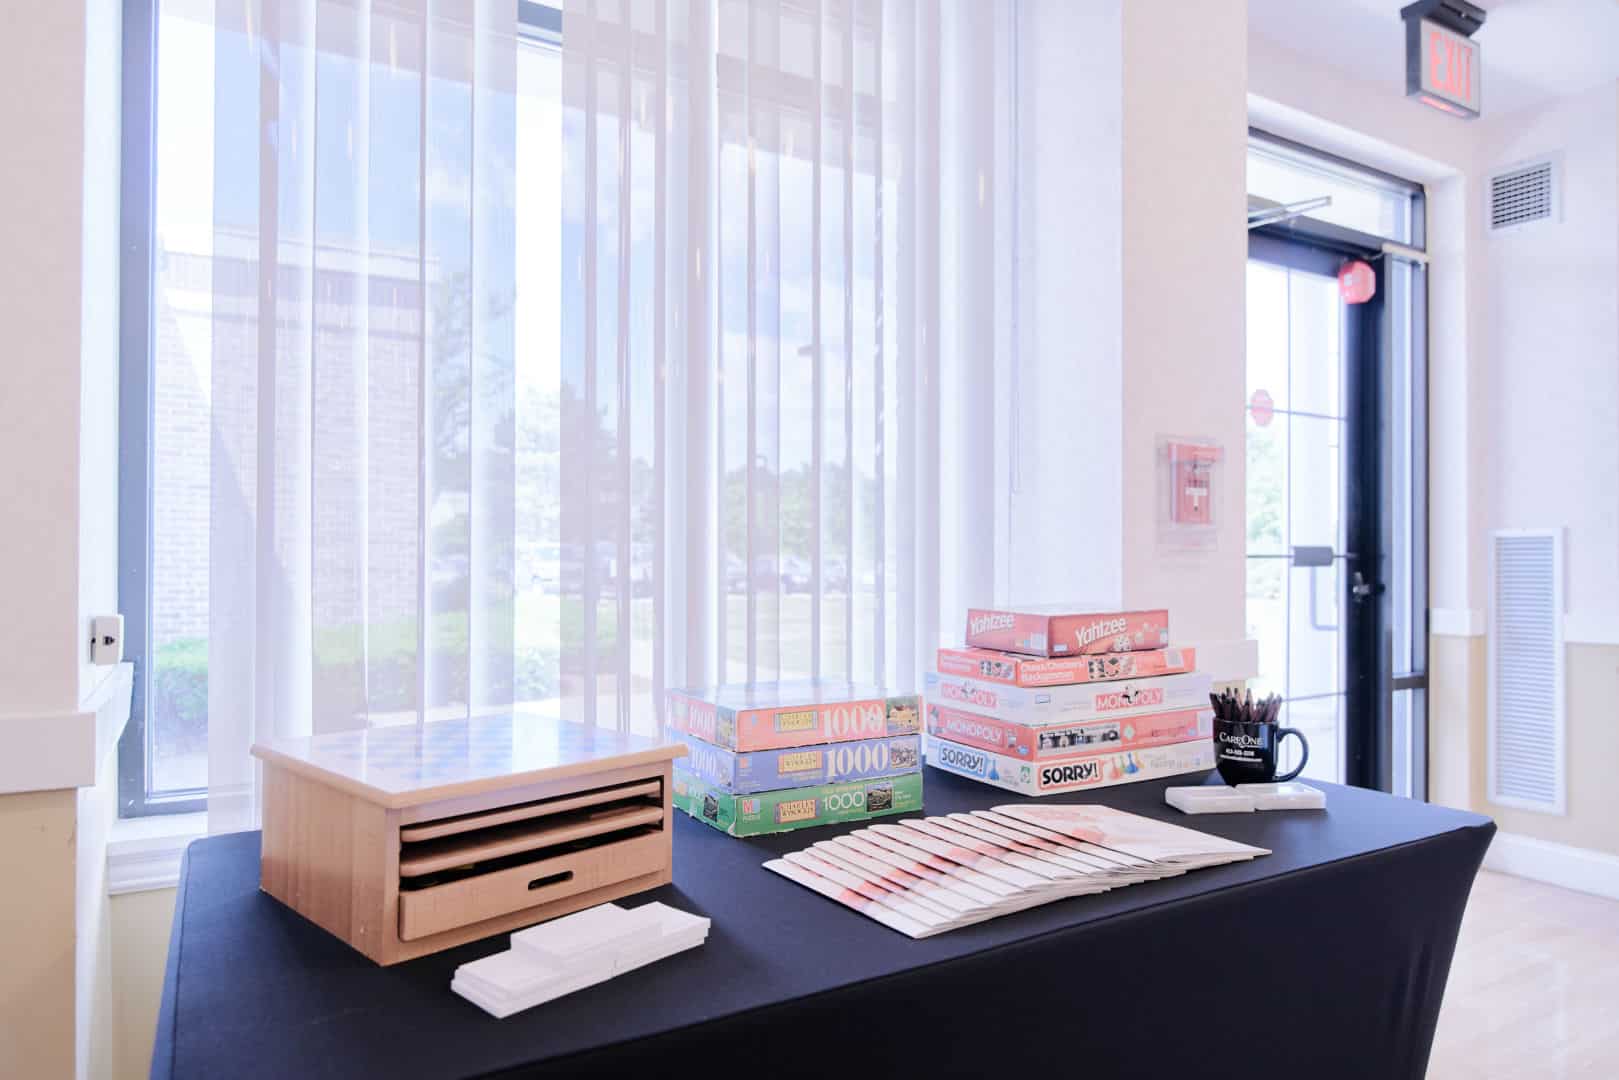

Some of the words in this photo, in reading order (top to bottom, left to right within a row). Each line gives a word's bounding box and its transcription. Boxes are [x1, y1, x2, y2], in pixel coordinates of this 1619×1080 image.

[1430, 32, 1473, 102] EXIT
[970, 614, 1015, 637] Yahtzee
[1075, 617, 1128, 648] Yahtzee
[823, 703, 883, 738] 1000
[945, 718, 1002, 745] MONOPOLY
[825, 743, 889, 777] 1000
[941, 747, 985, 773] SORRY!
[1042, 762, 1098, 785] SORRY!
[823, 791, 866, 811] 1000
